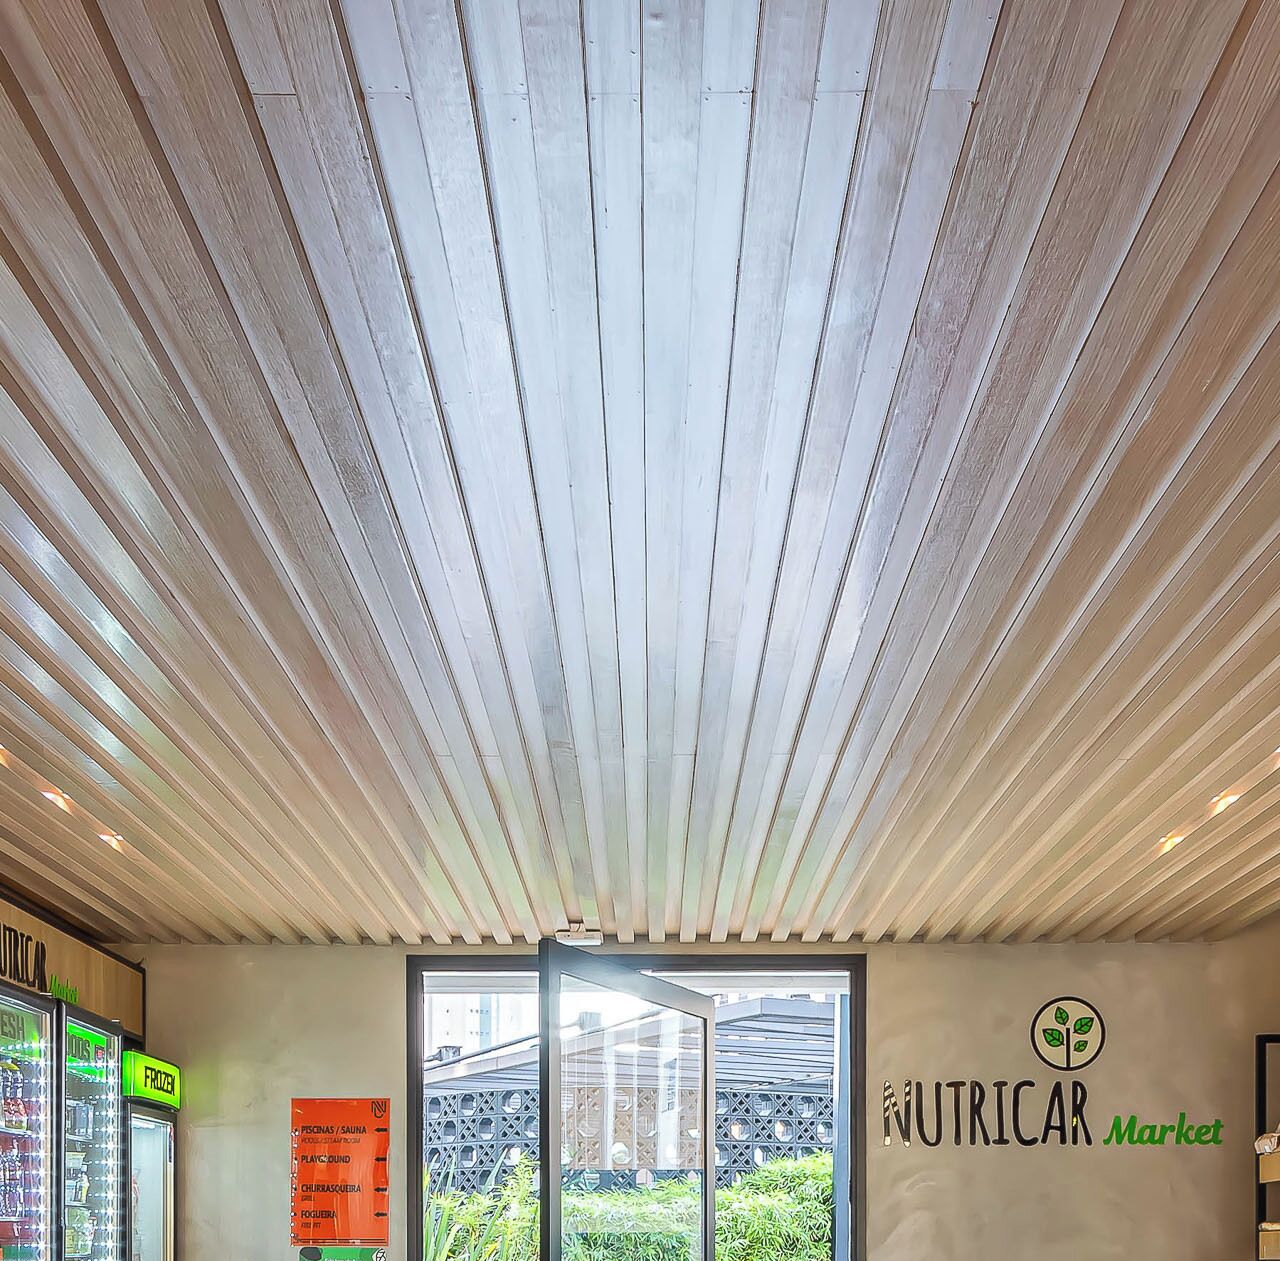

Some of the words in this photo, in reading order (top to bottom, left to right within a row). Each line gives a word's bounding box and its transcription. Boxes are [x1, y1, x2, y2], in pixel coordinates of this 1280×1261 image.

[144, 1065, 176, 1096] FROZEN
[882, 1079, 1094, 1148] NUTRICAR
[1102, 1112, 1224, 1147] Market
[301, 1125, 335, 1134] PISCINAS
[335, 1126, 339, 1135] /
[341, 1125, 367, 1134] SAUNA
[301, 1155, 351, 1164] PLAYGROUND
[301, 1184, 361, 1193] CHURRASQUEIRA
[301, 1210, 337, 1219] FOGUEIRA
